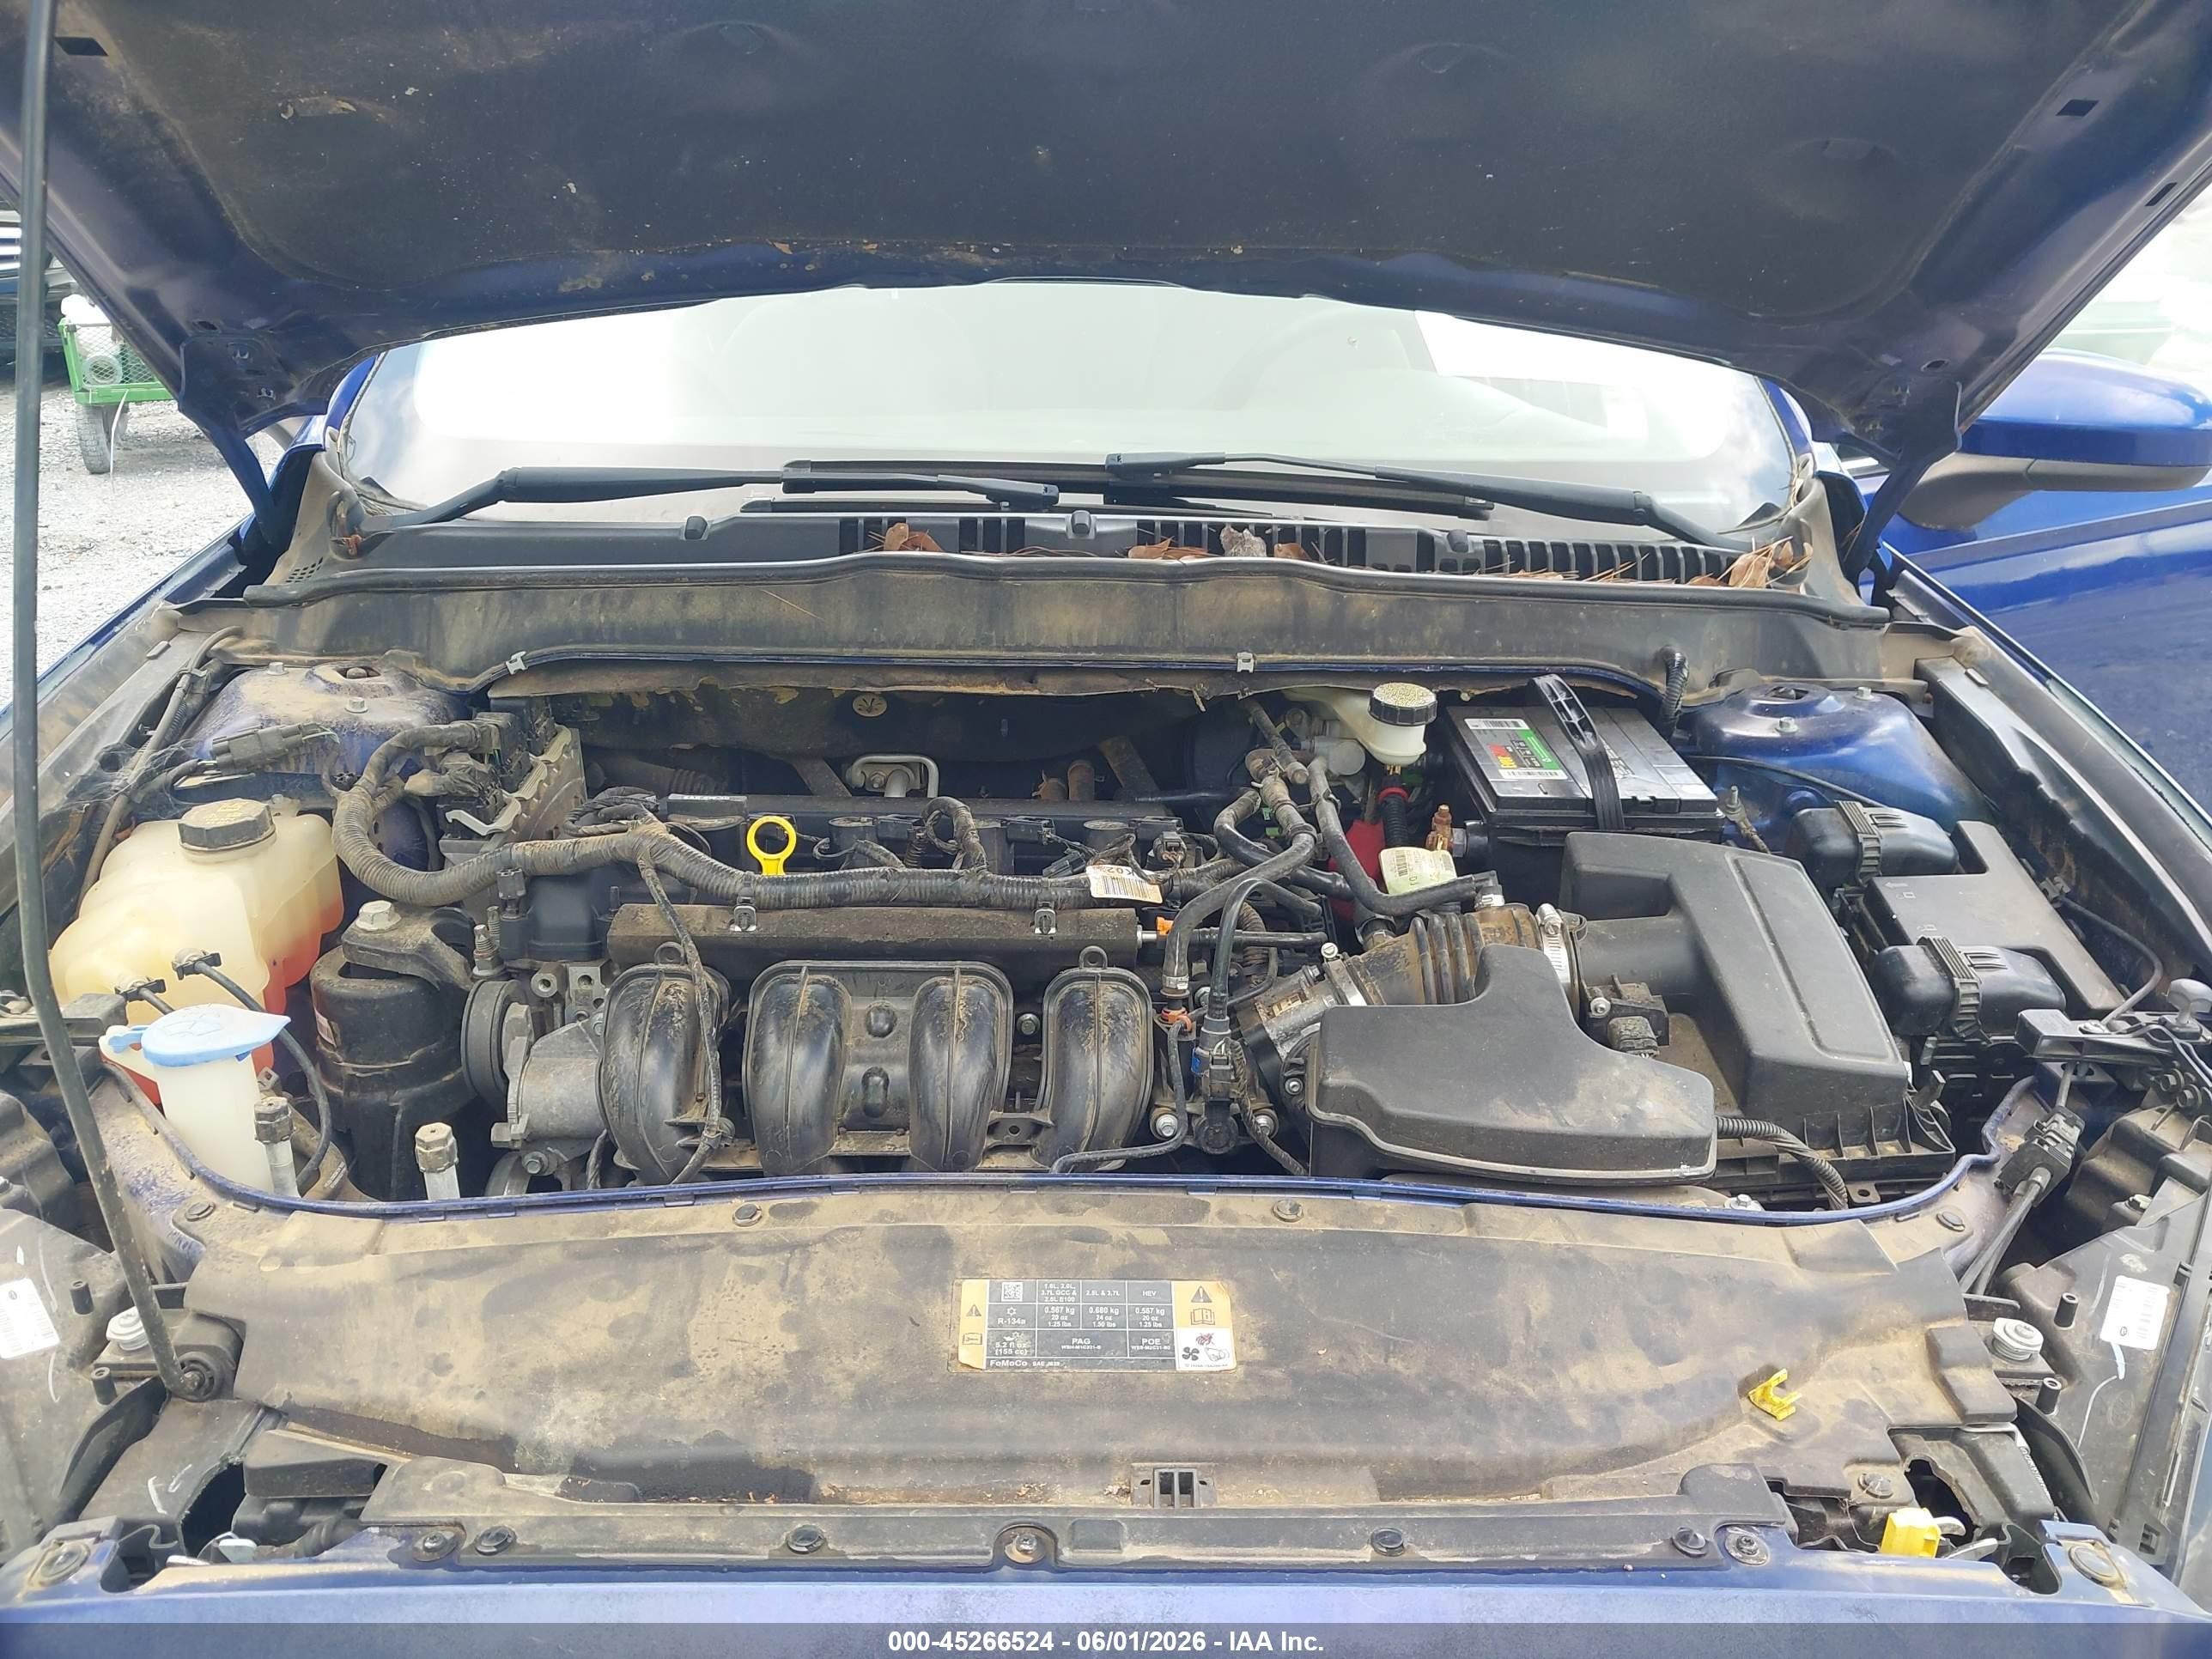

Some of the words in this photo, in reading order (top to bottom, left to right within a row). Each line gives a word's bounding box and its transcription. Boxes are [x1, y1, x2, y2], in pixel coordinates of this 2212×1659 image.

[1065, 1306, 1075, 1315] kg
[1109, 1306, 1120, 1316] kg
[1156, 1307, 1165, 1316] kg
